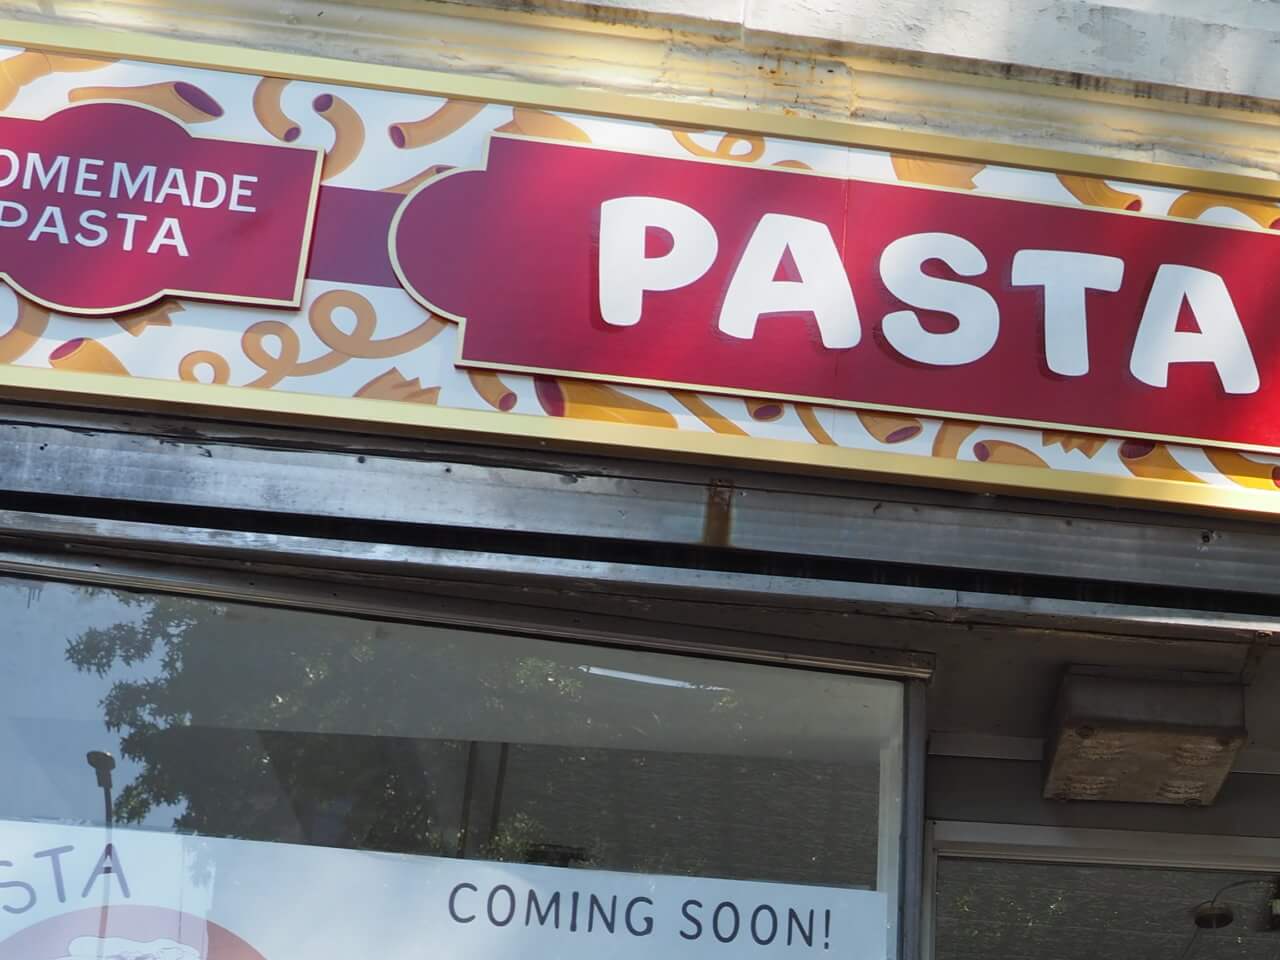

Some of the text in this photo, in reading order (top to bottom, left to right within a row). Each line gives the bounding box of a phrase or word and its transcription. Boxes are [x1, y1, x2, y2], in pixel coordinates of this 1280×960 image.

[0, 200, 189, 257] PASTA
[599, 196, 1260, 395] PASTA
[447, 882, 833, 950] COMING SOON!
